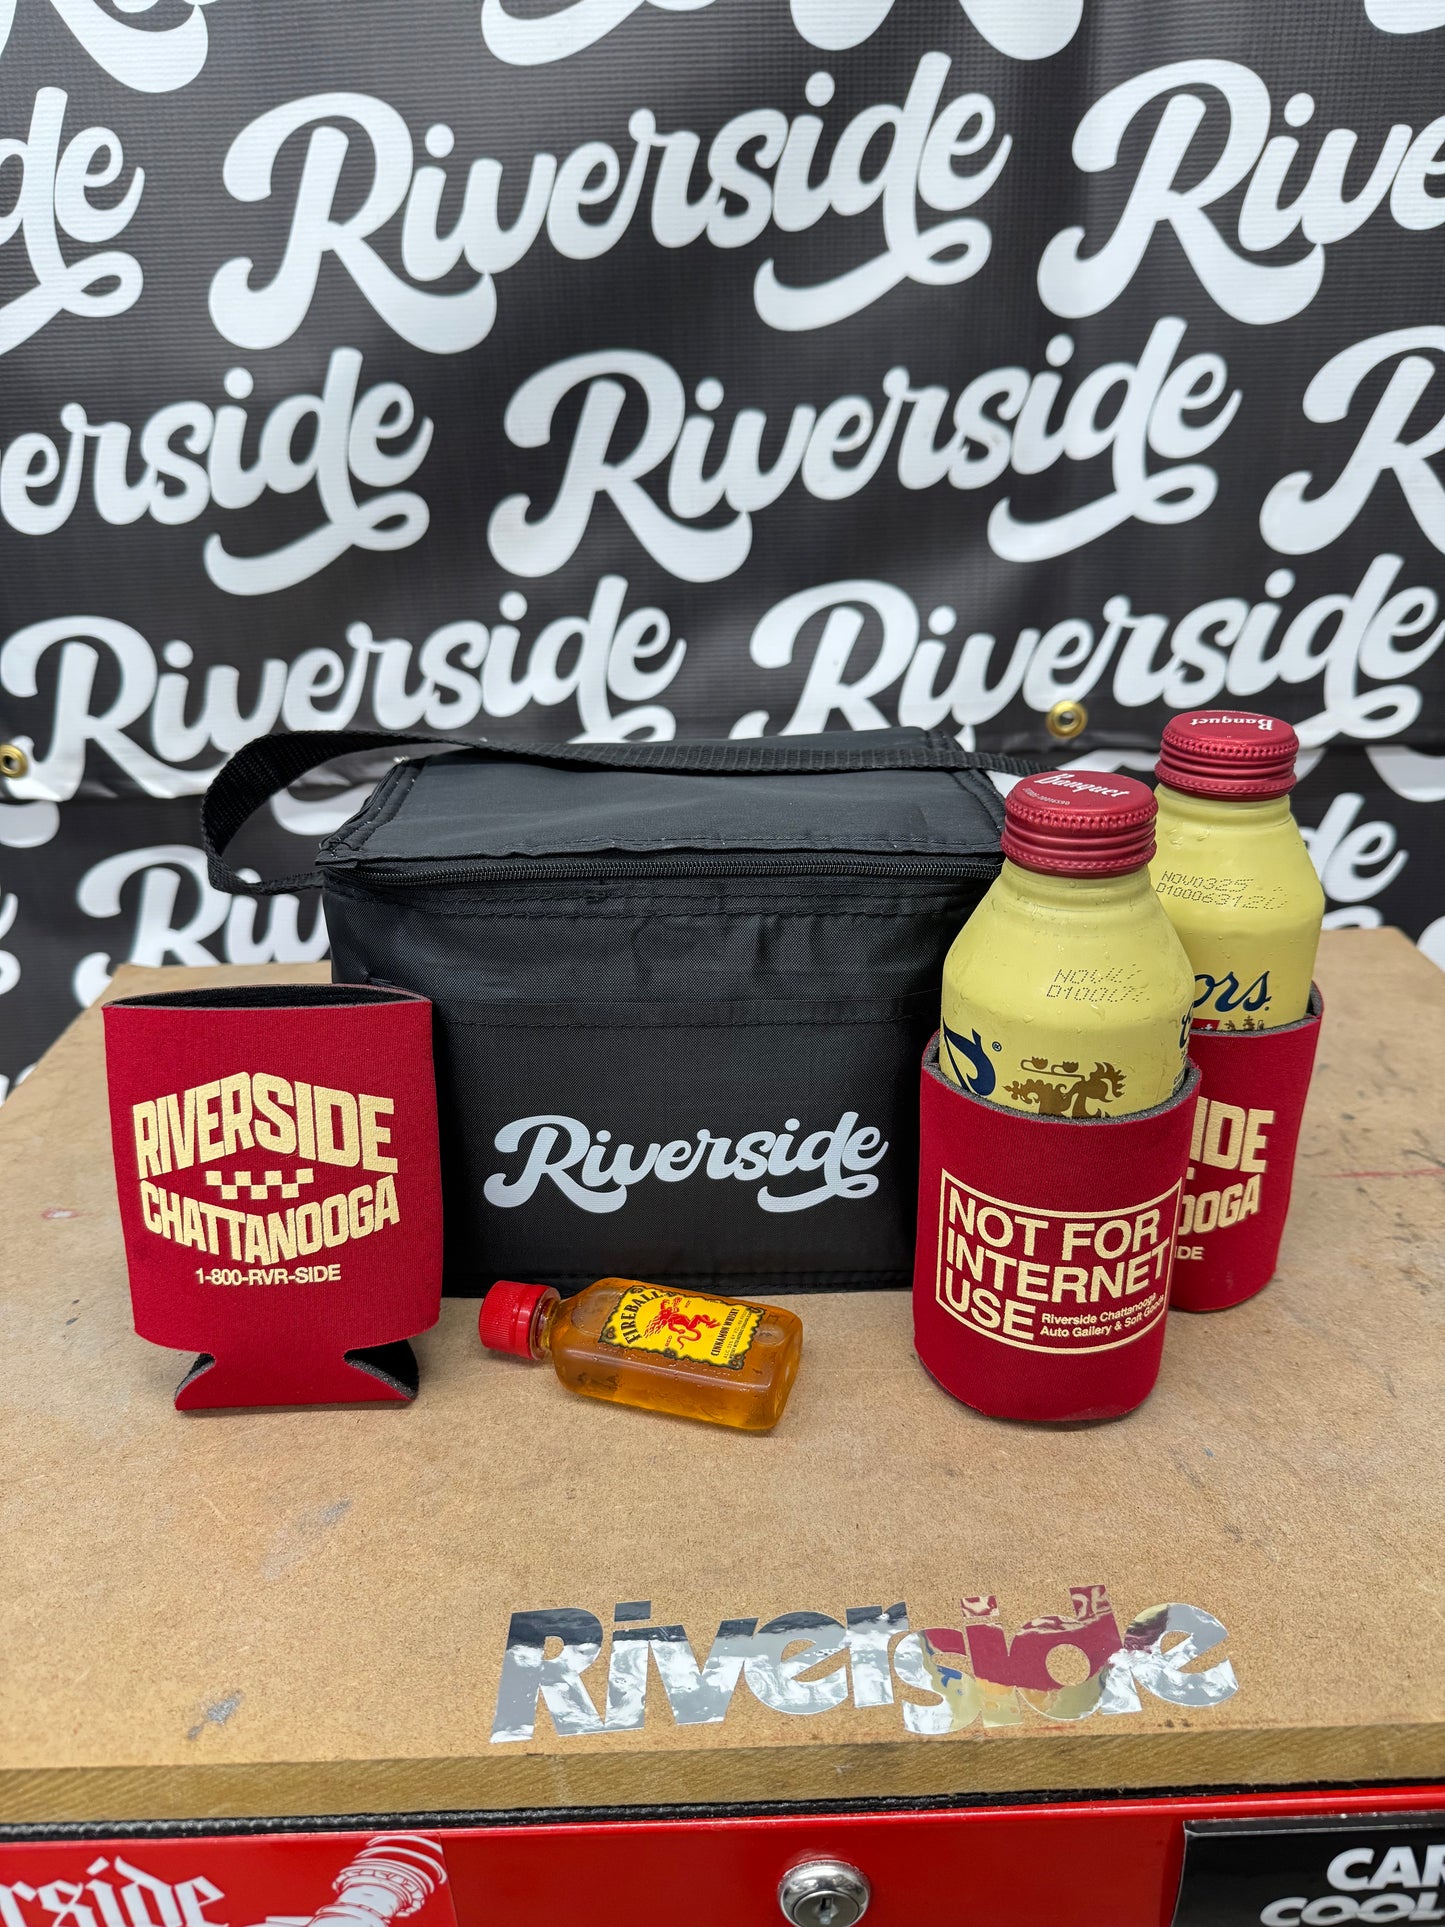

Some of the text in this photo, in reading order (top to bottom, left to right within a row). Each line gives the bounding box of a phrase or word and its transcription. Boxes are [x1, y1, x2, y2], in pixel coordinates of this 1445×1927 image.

[209, 52, 1013, 354] Riverside
[488, 316, 1242, 582] Riverside
[0, 575, 686, 801] Riverside
[1190, 716, 1273, 731] Banquet
[1034, 773, 1130, 797] Banquet
[133, 1072, 398, 1180] RIVERSIDE
[484, 1111, 888, 1213] Riverside
[140, 1175, 401, 1265] CHATTANOOGA
[948, 1187, 1160, 1260] NOT FOR
[195, 1264, 341, 1285] 1-800-RVR-SIDE
[946, 1227, 1170, 1303] INTERNET
[621, 1291, 663, 1344] FIREBALL
[711, 1326, 730, 1356] CINNAMON
[945, 1268, 1035, 1341] USE
[1039, 1326, 1069, 1337] Auto
[1072, 1324, 1112, 1337] Gallery
[1114, 1320, 1122, 1331] &
[1124, 1313, 1142, 1327] Soft
[1041, 1292, 1157, 1326] Riverside Chattanooga
[491, 1584, 1239, 1744] Riverside
